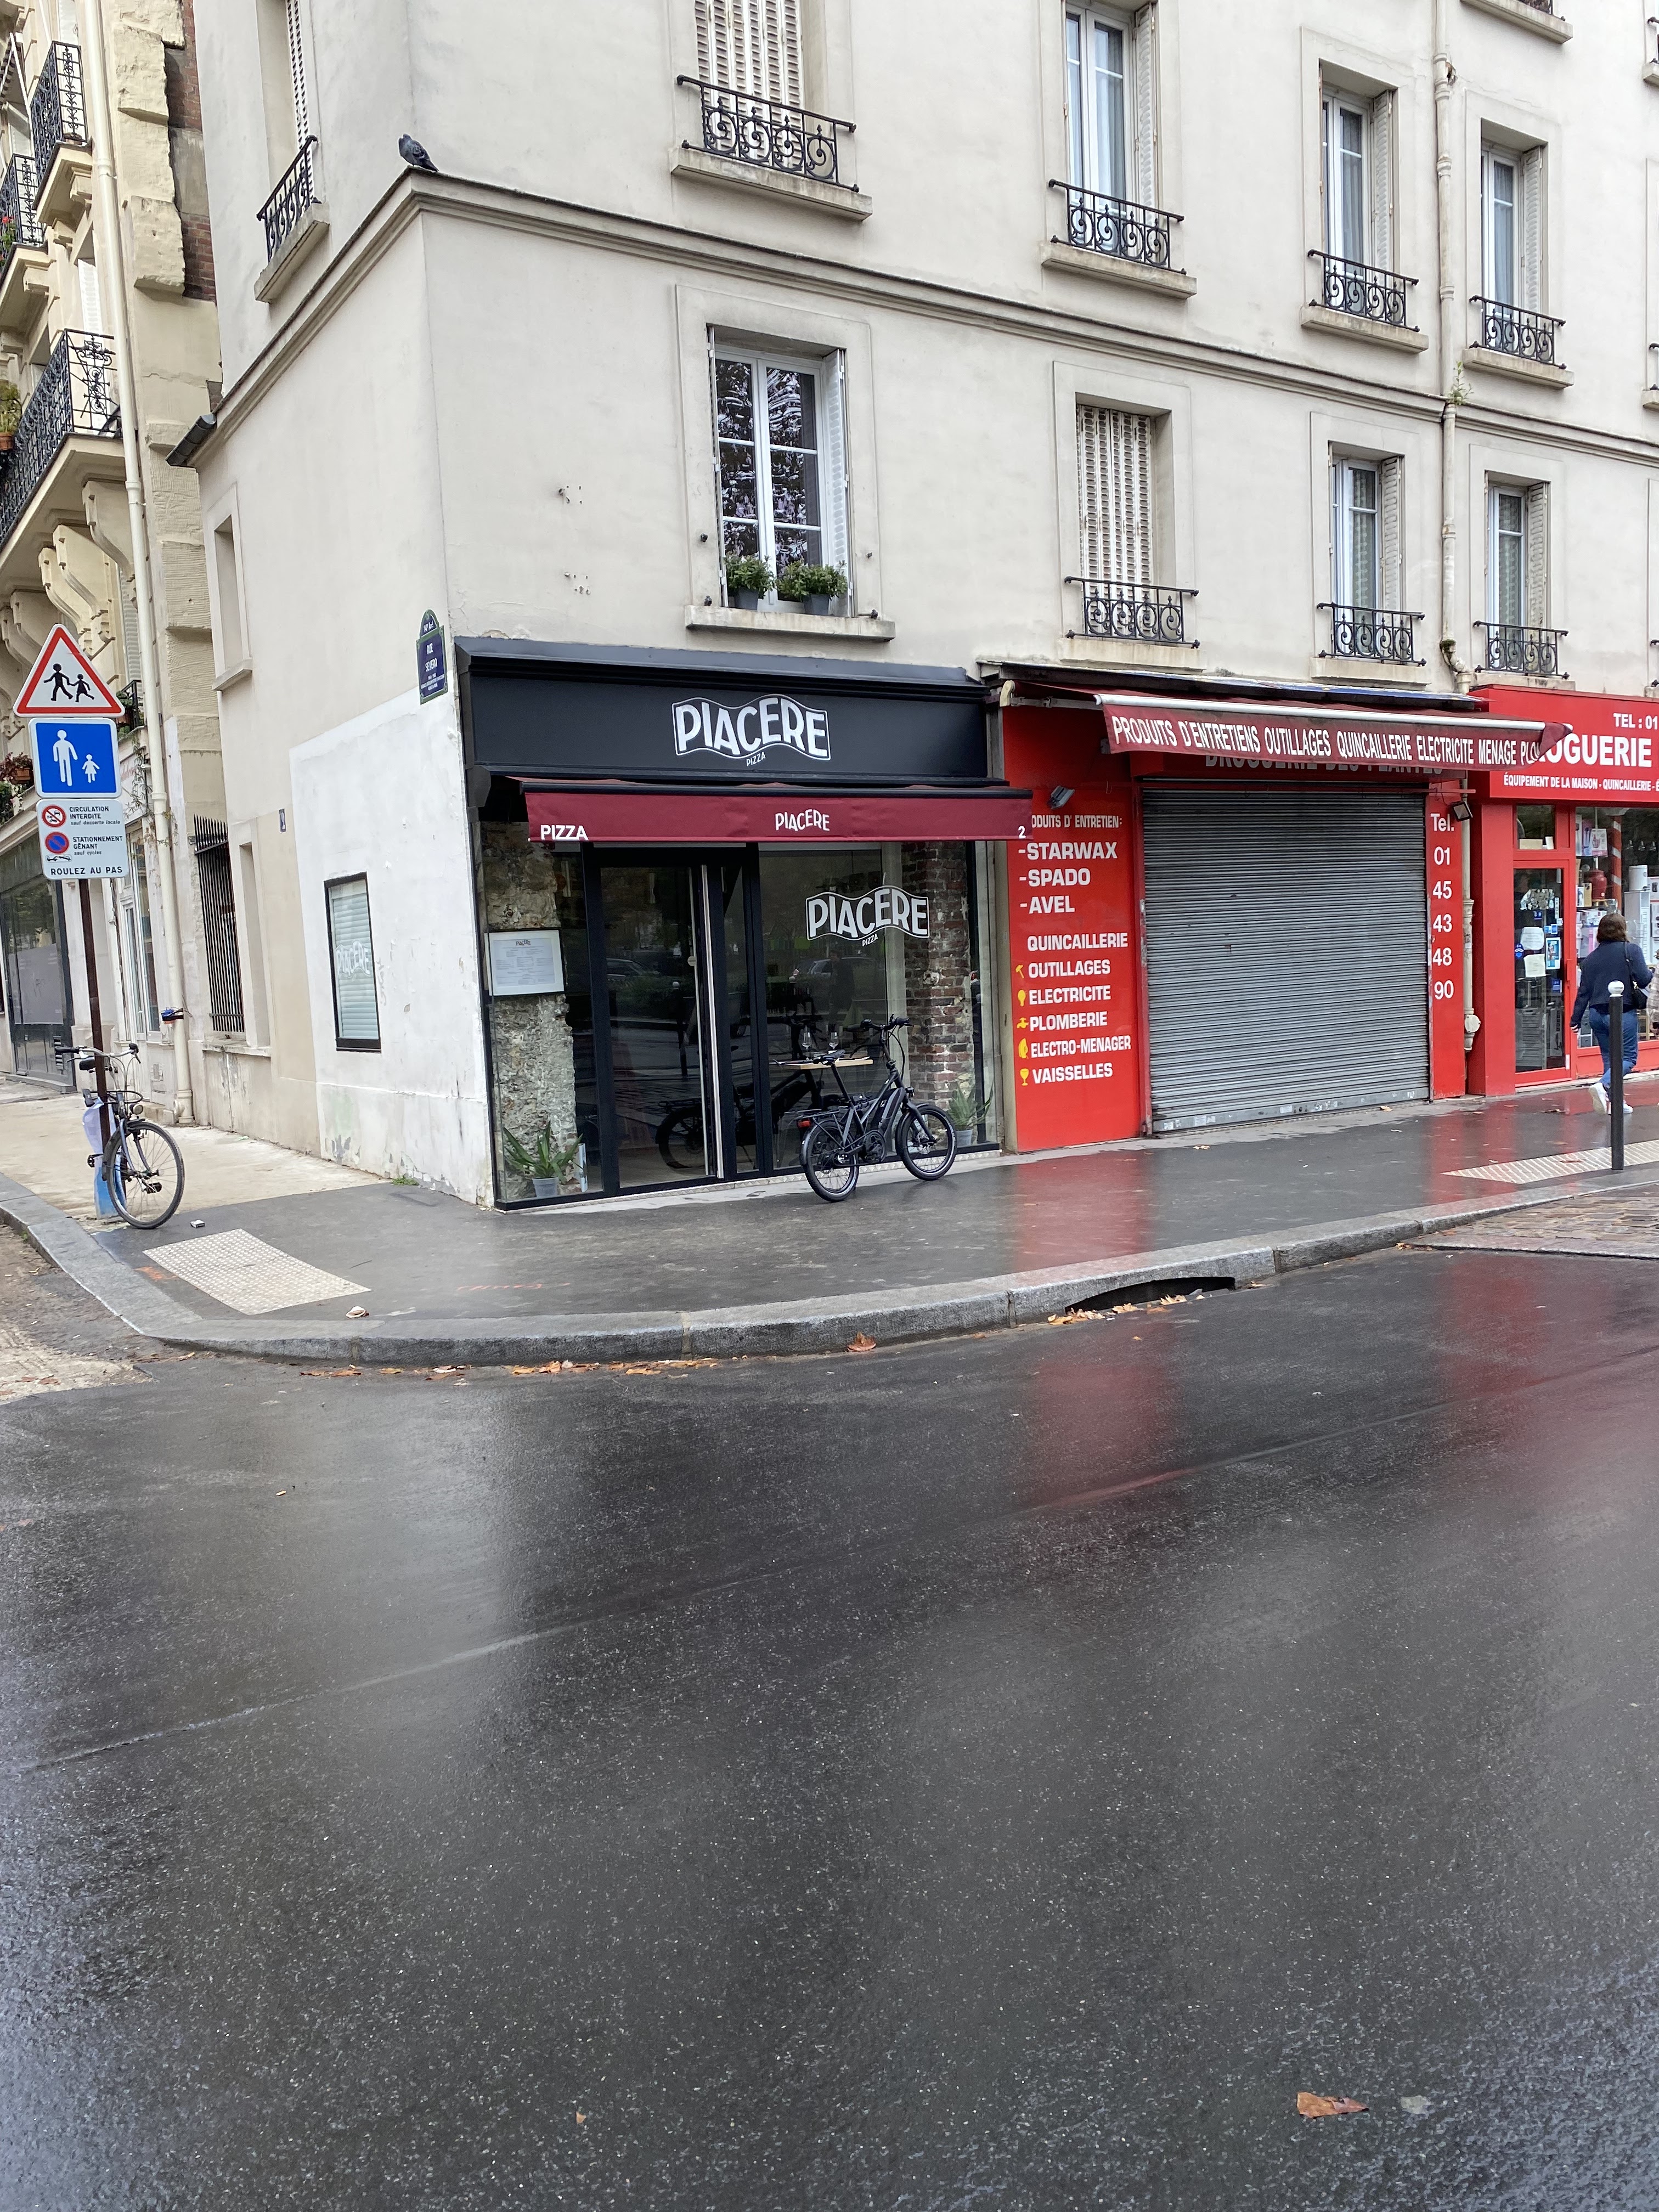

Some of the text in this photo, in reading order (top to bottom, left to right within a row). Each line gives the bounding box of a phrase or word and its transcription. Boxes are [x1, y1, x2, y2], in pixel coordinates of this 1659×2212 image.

[675, 697, 828, 757] PIACERE
[1645, 715, 1658, 730] 01
[1111, 715, 1178, 747] PRODUITS
[1177, 720, 1261, 753] D'ENTRETIENS
[1264, 726, 1331, 757] OUTILLAGES
[1336, 730, 1413, 760] QUINCAILLERIE
[1416, 735, 1474, 764] ELECTRICITE
[1478, 739, 1517, 765] MENAGE
[746, 752, 766, 766] PIZZA
[1538, 733, 1652, 768] OGUERIE
[1504, 771, 1549, 787] ÉQUIPEMENT
[1550, 776, 1560, 788] DE
[1561, 777, 1570, 788] LA
[1571, 778, 1598, 789] MAISON
[1602, 779, 1651, 791] QUINCAILLERIE
[775, 809, 831, 831] PIACERE
[1031, 814, 1061, 828] ODUITS
[1430, 813, 1454, 832] Tel.
[540, 825, 589, 840] PIZZA
[1018, 826, 1026, 838] 2
[1434, 847, 1451, 865] 01
[1432, 881, 1452, 899] 45
[808, 888, 928, 938] PIACERE
[1432, 913, 1452, 933] 43
[862, 934, 878, 946] PIZZA
[1028, 933, 1128, 951] QUINCAILLERIE
[1432, 947, 1452, 966] 48
[1028, 959, 1111, 979] OUTILLAGES
[1029, 985, 1111, 1005] ELECTRICITE
[1434, 980, 1454, 1000] 90
[1029, 1011, 1108, 1031] PLOMBERIE
[1031, 1035, 1131, 1058] ELECTRO-MENAGER
[1032, 1062, 1113, 1084] VAISSELLES
